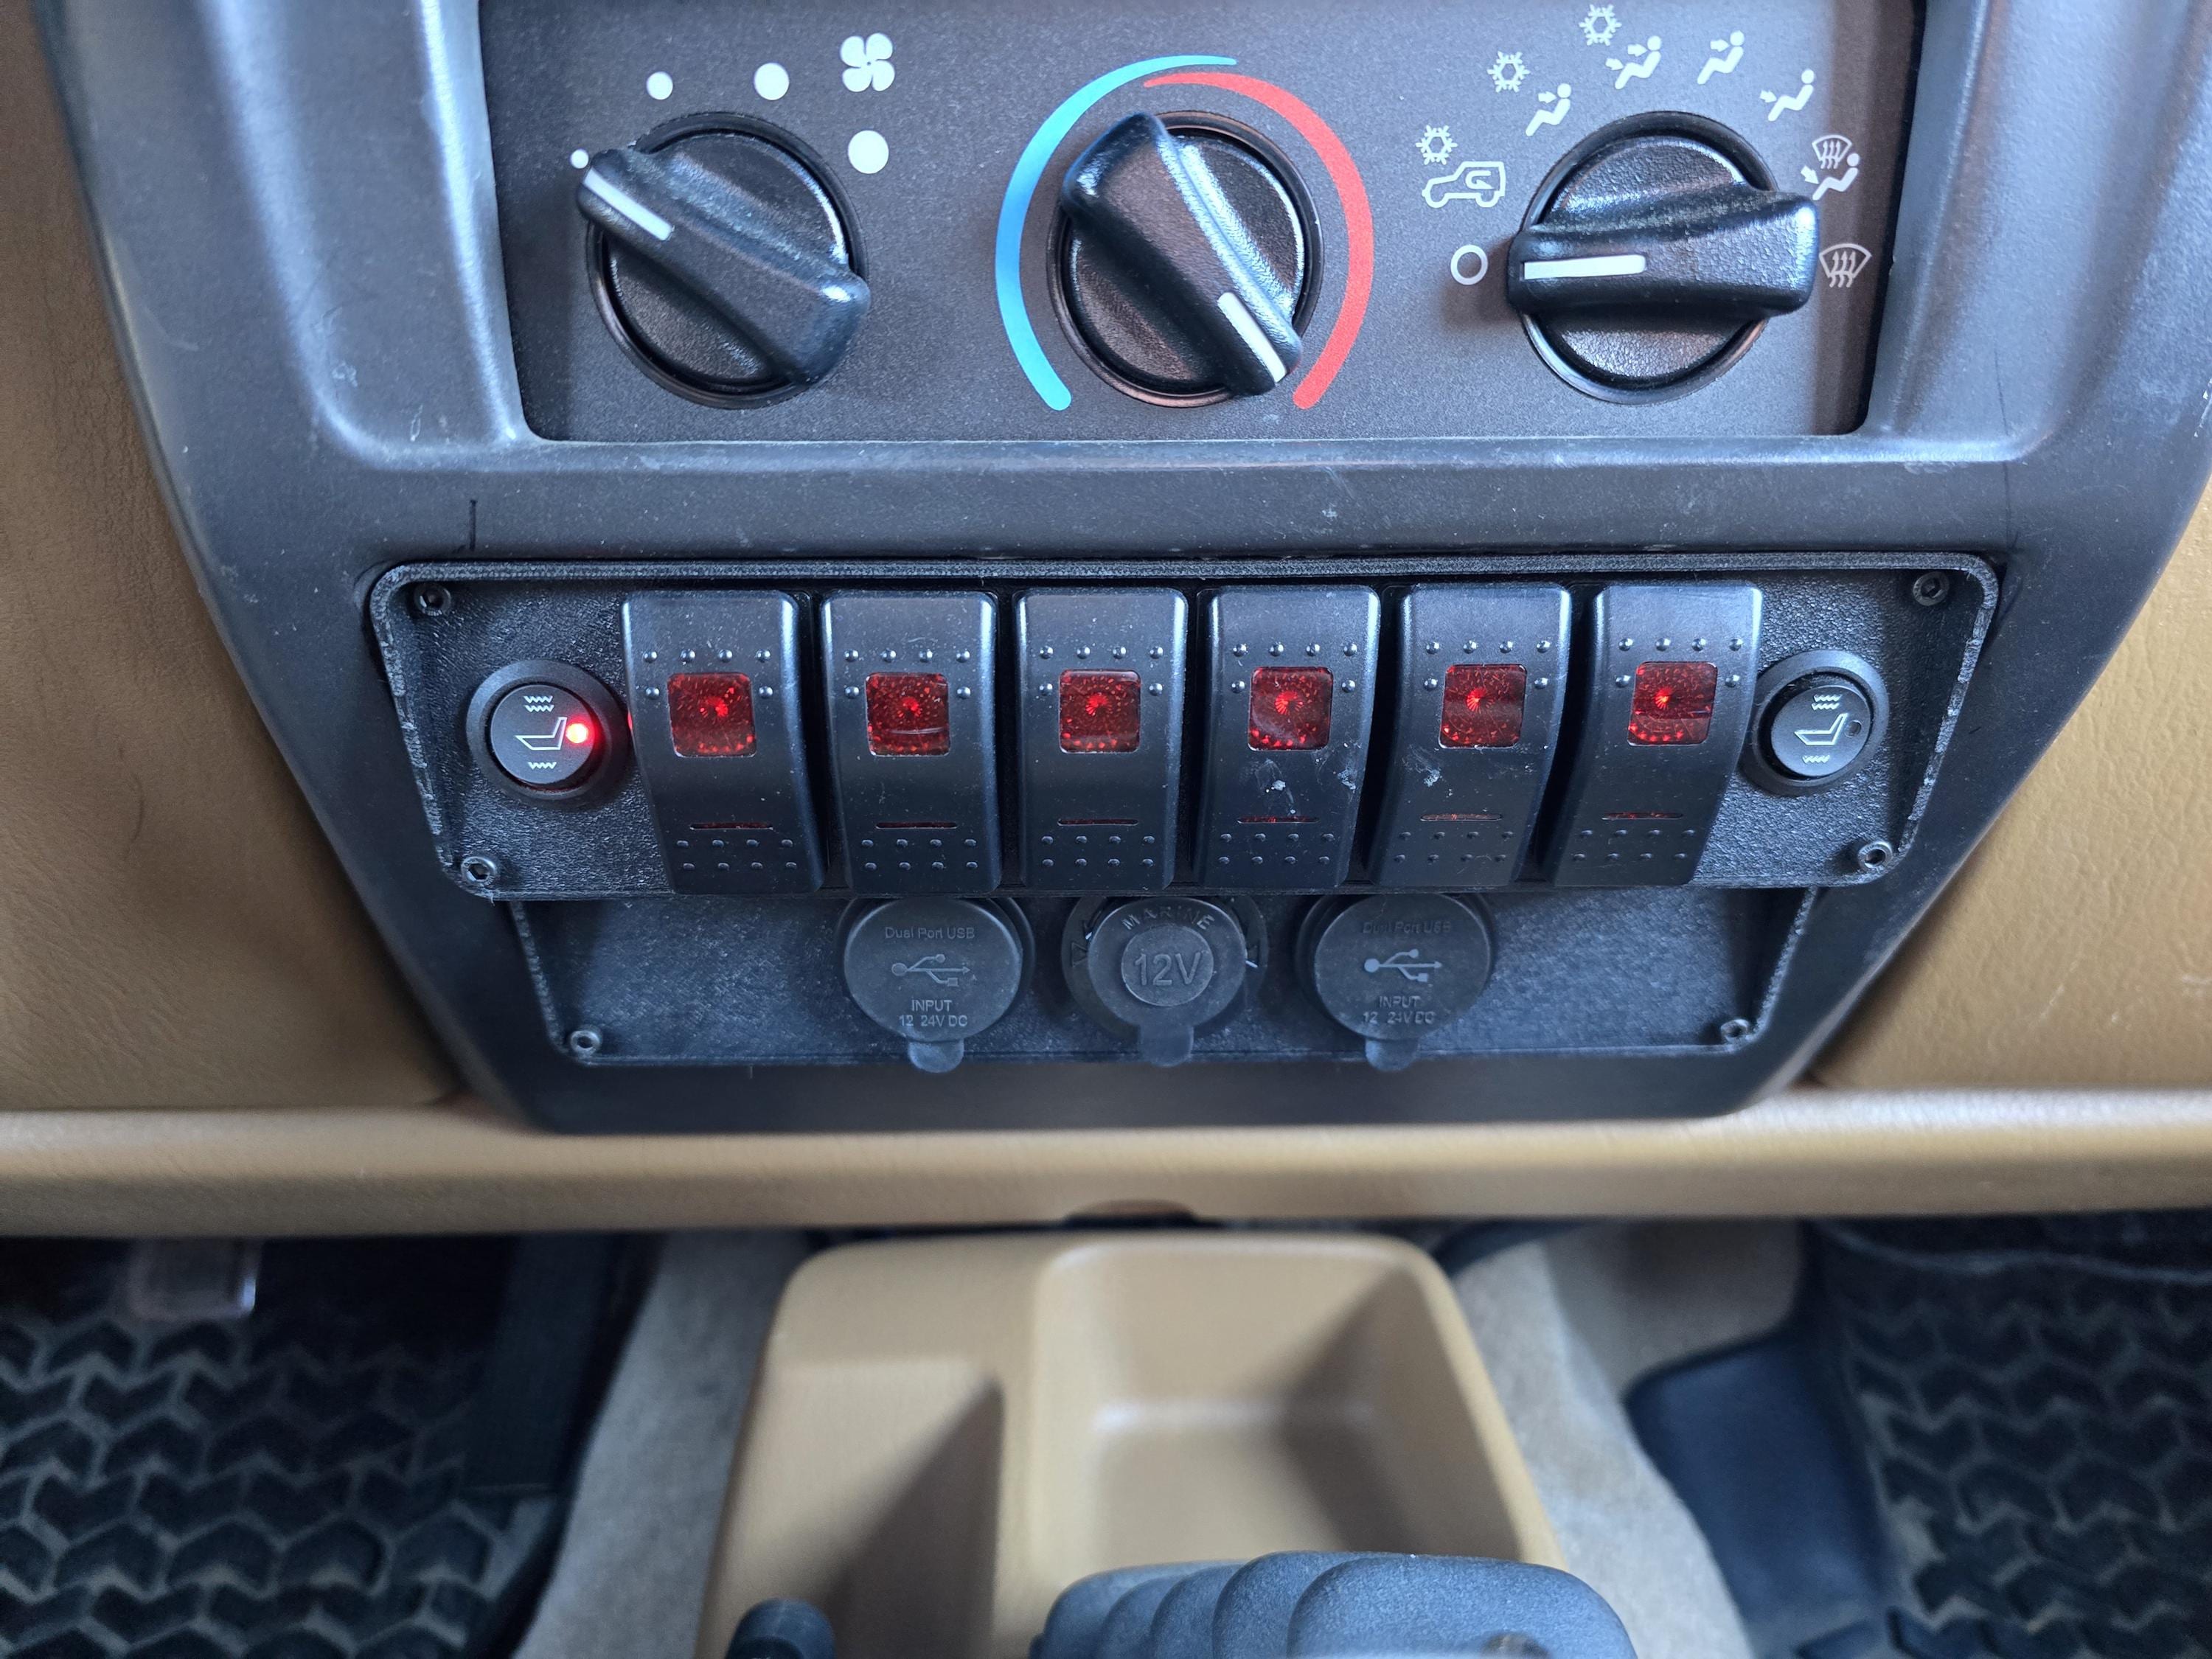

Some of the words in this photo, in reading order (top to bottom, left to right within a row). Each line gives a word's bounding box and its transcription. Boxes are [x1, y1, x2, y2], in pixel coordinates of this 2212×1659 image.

[885, 926, 914, 939] Dual
[917, 927, 943, 939] Port
[947, 927, 975, 939] USB
[1134, 951, 1203, 986] 12V
[911, 999, 953, 1012] INPUT
[1379, 995, 1421, 1009] INPUT
[947, 1015, 968, 1027] DC
